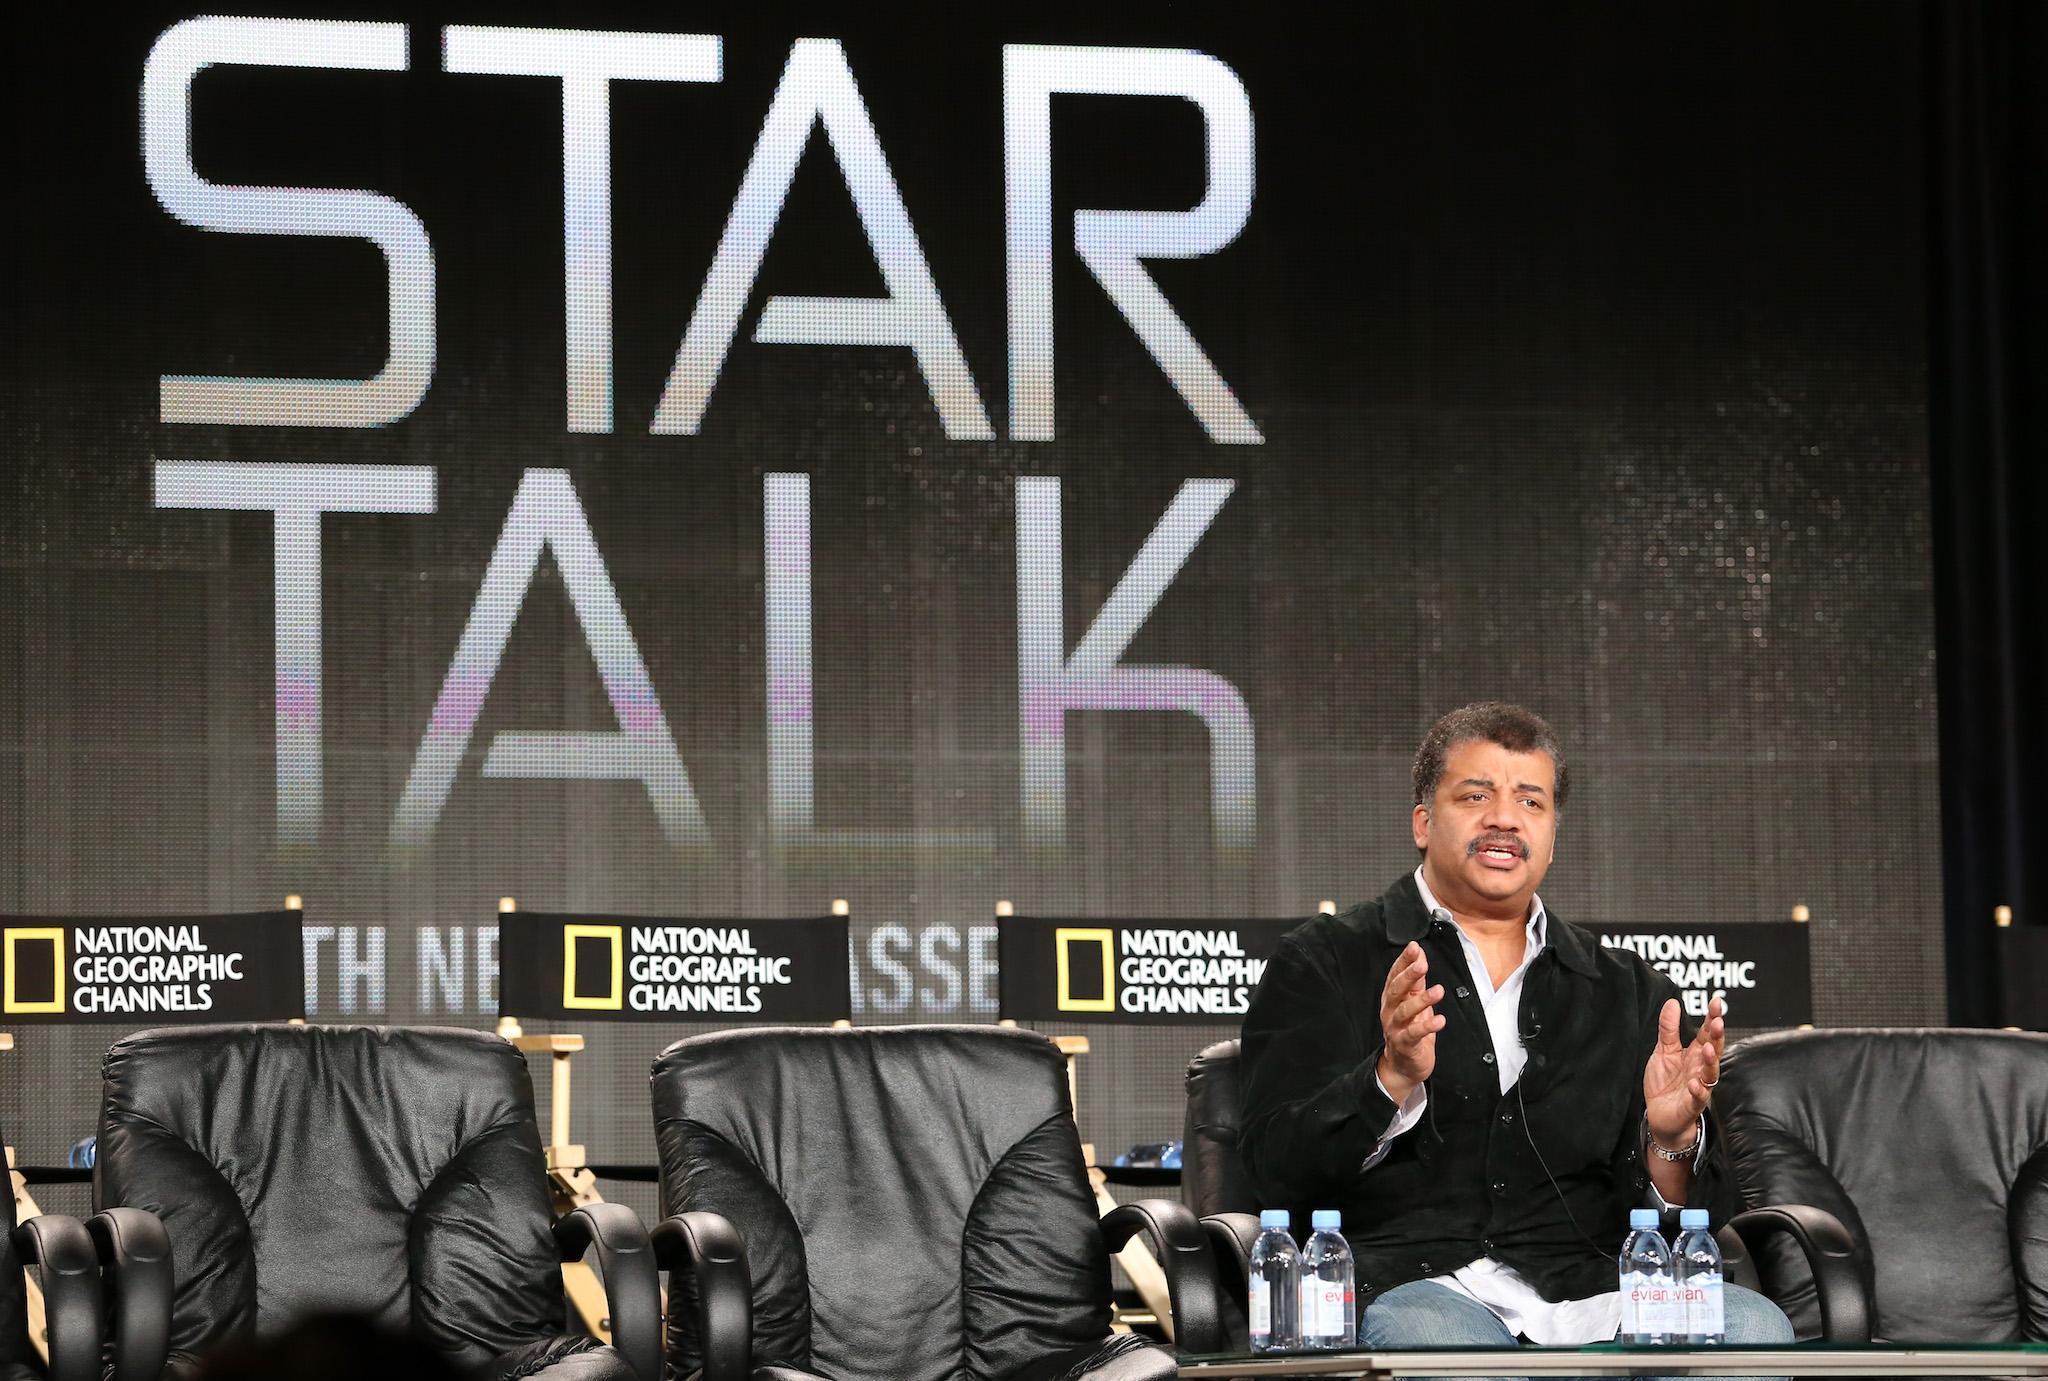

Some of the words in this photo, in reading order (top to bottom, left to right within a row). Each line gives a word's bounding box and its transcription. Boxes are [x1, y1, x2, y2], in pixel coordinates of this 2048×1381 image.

[139, 14, 1265, 444] STAR
[151, 459, 1257, 862] TALK
[74, 925, 208, 954] NATIONAL
[630, 926, 757, 955] NATIONAL
[1120, 928, 1246, 957] NATIONAL
[73, 953, 243, 984] GEOGRAPHIC
[629, 954, 792, 984] GEOGRAPHIC
[73, 984, 213, 1013] CHANNELS
[628, 984, 762, 1013] CHANNELS
[1120, 986, 1250, 1014] CHANNELS
[1631, 1287, 1669, 1302] evian
[1672, 1288, 1704, 1301] vian
